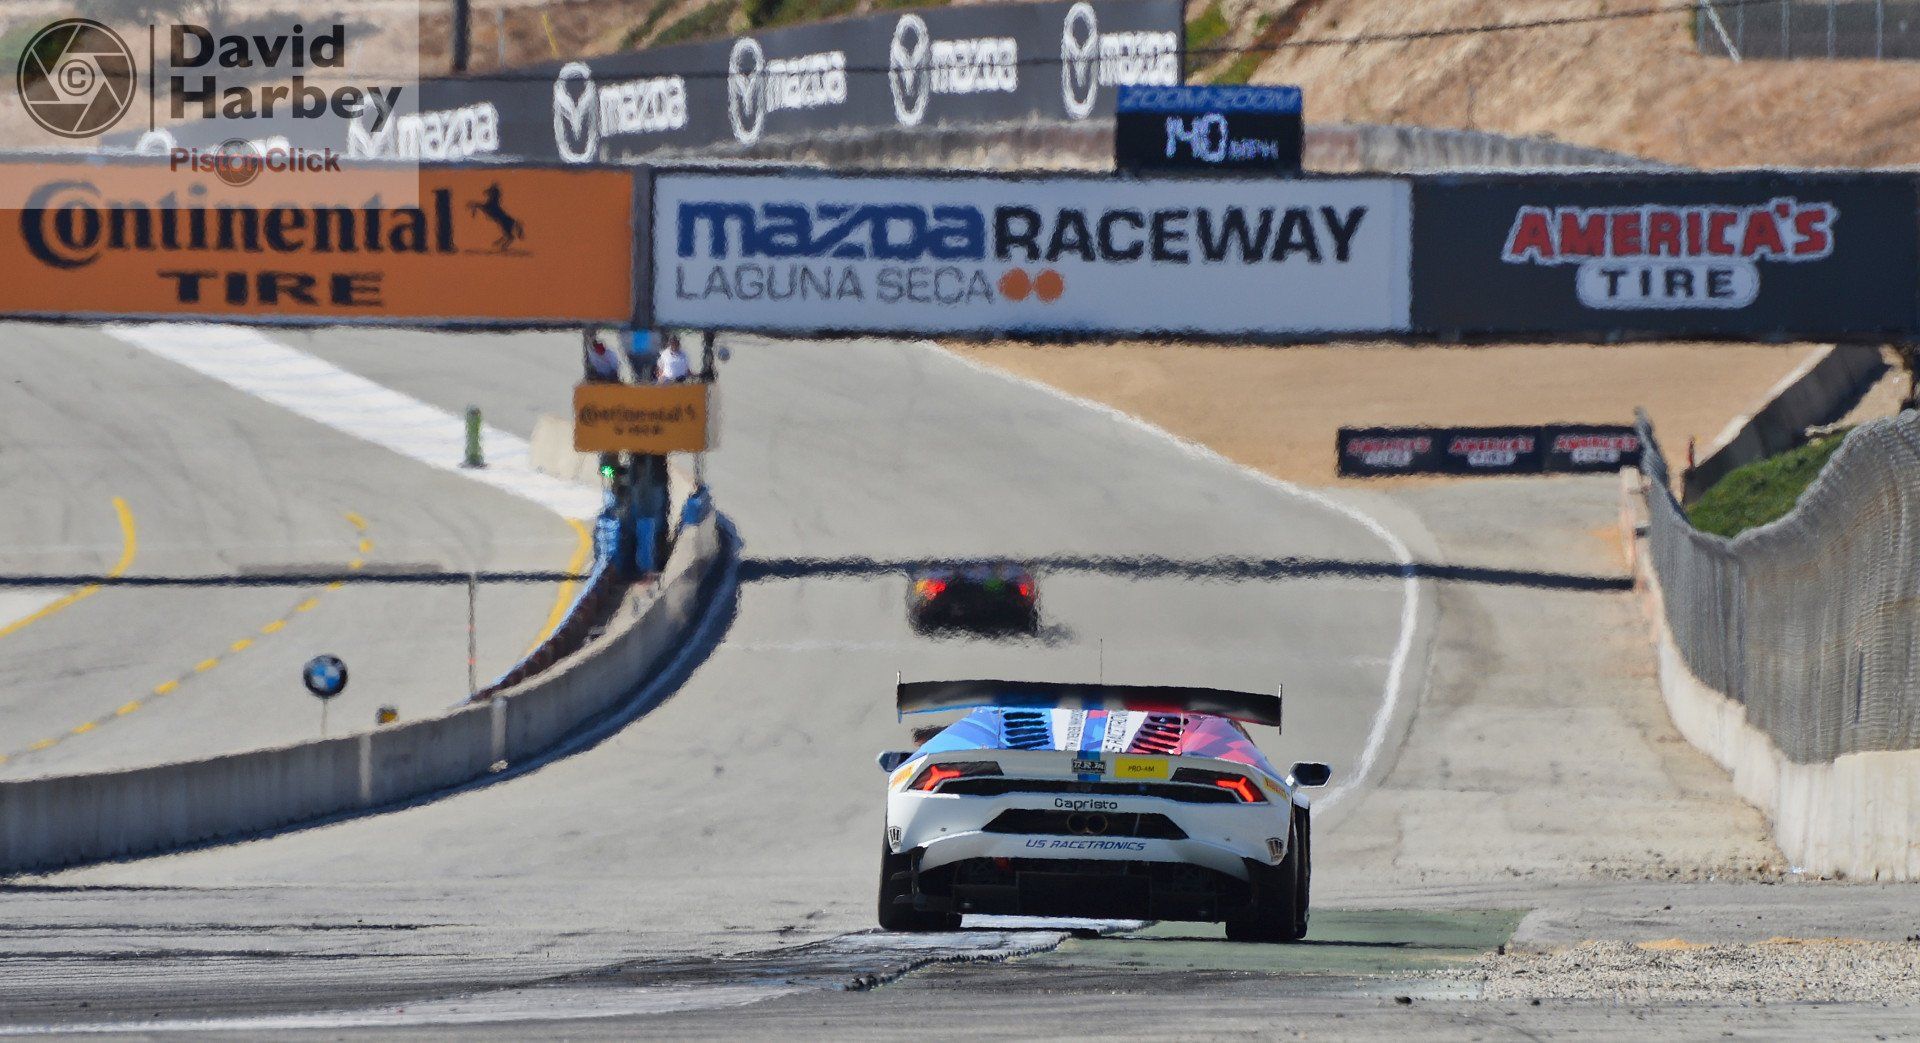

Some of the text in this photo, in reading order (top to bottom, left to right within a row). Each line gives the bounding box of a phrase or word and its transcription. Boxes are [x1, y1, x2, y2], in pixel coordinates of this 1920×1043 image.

[1166, 113, 1228, 162] 140
[20, 180, 456, 268] Continental
[677, 202, 1368, 264] mazda RACEWAY
[1506, 200, 1834, 259] AMERICA'S
[157, 270, 384, 306] TIRE
[676, 264, 994, 303] LAGUNA SECA
[1599, 268, 1736, 300] TIRE
[1128, 765, 1155, 773] PRO-AM
[1054, 798, 1118, 812] Capristo
[1025, 839, 1147, 852] US RACETRONICS
